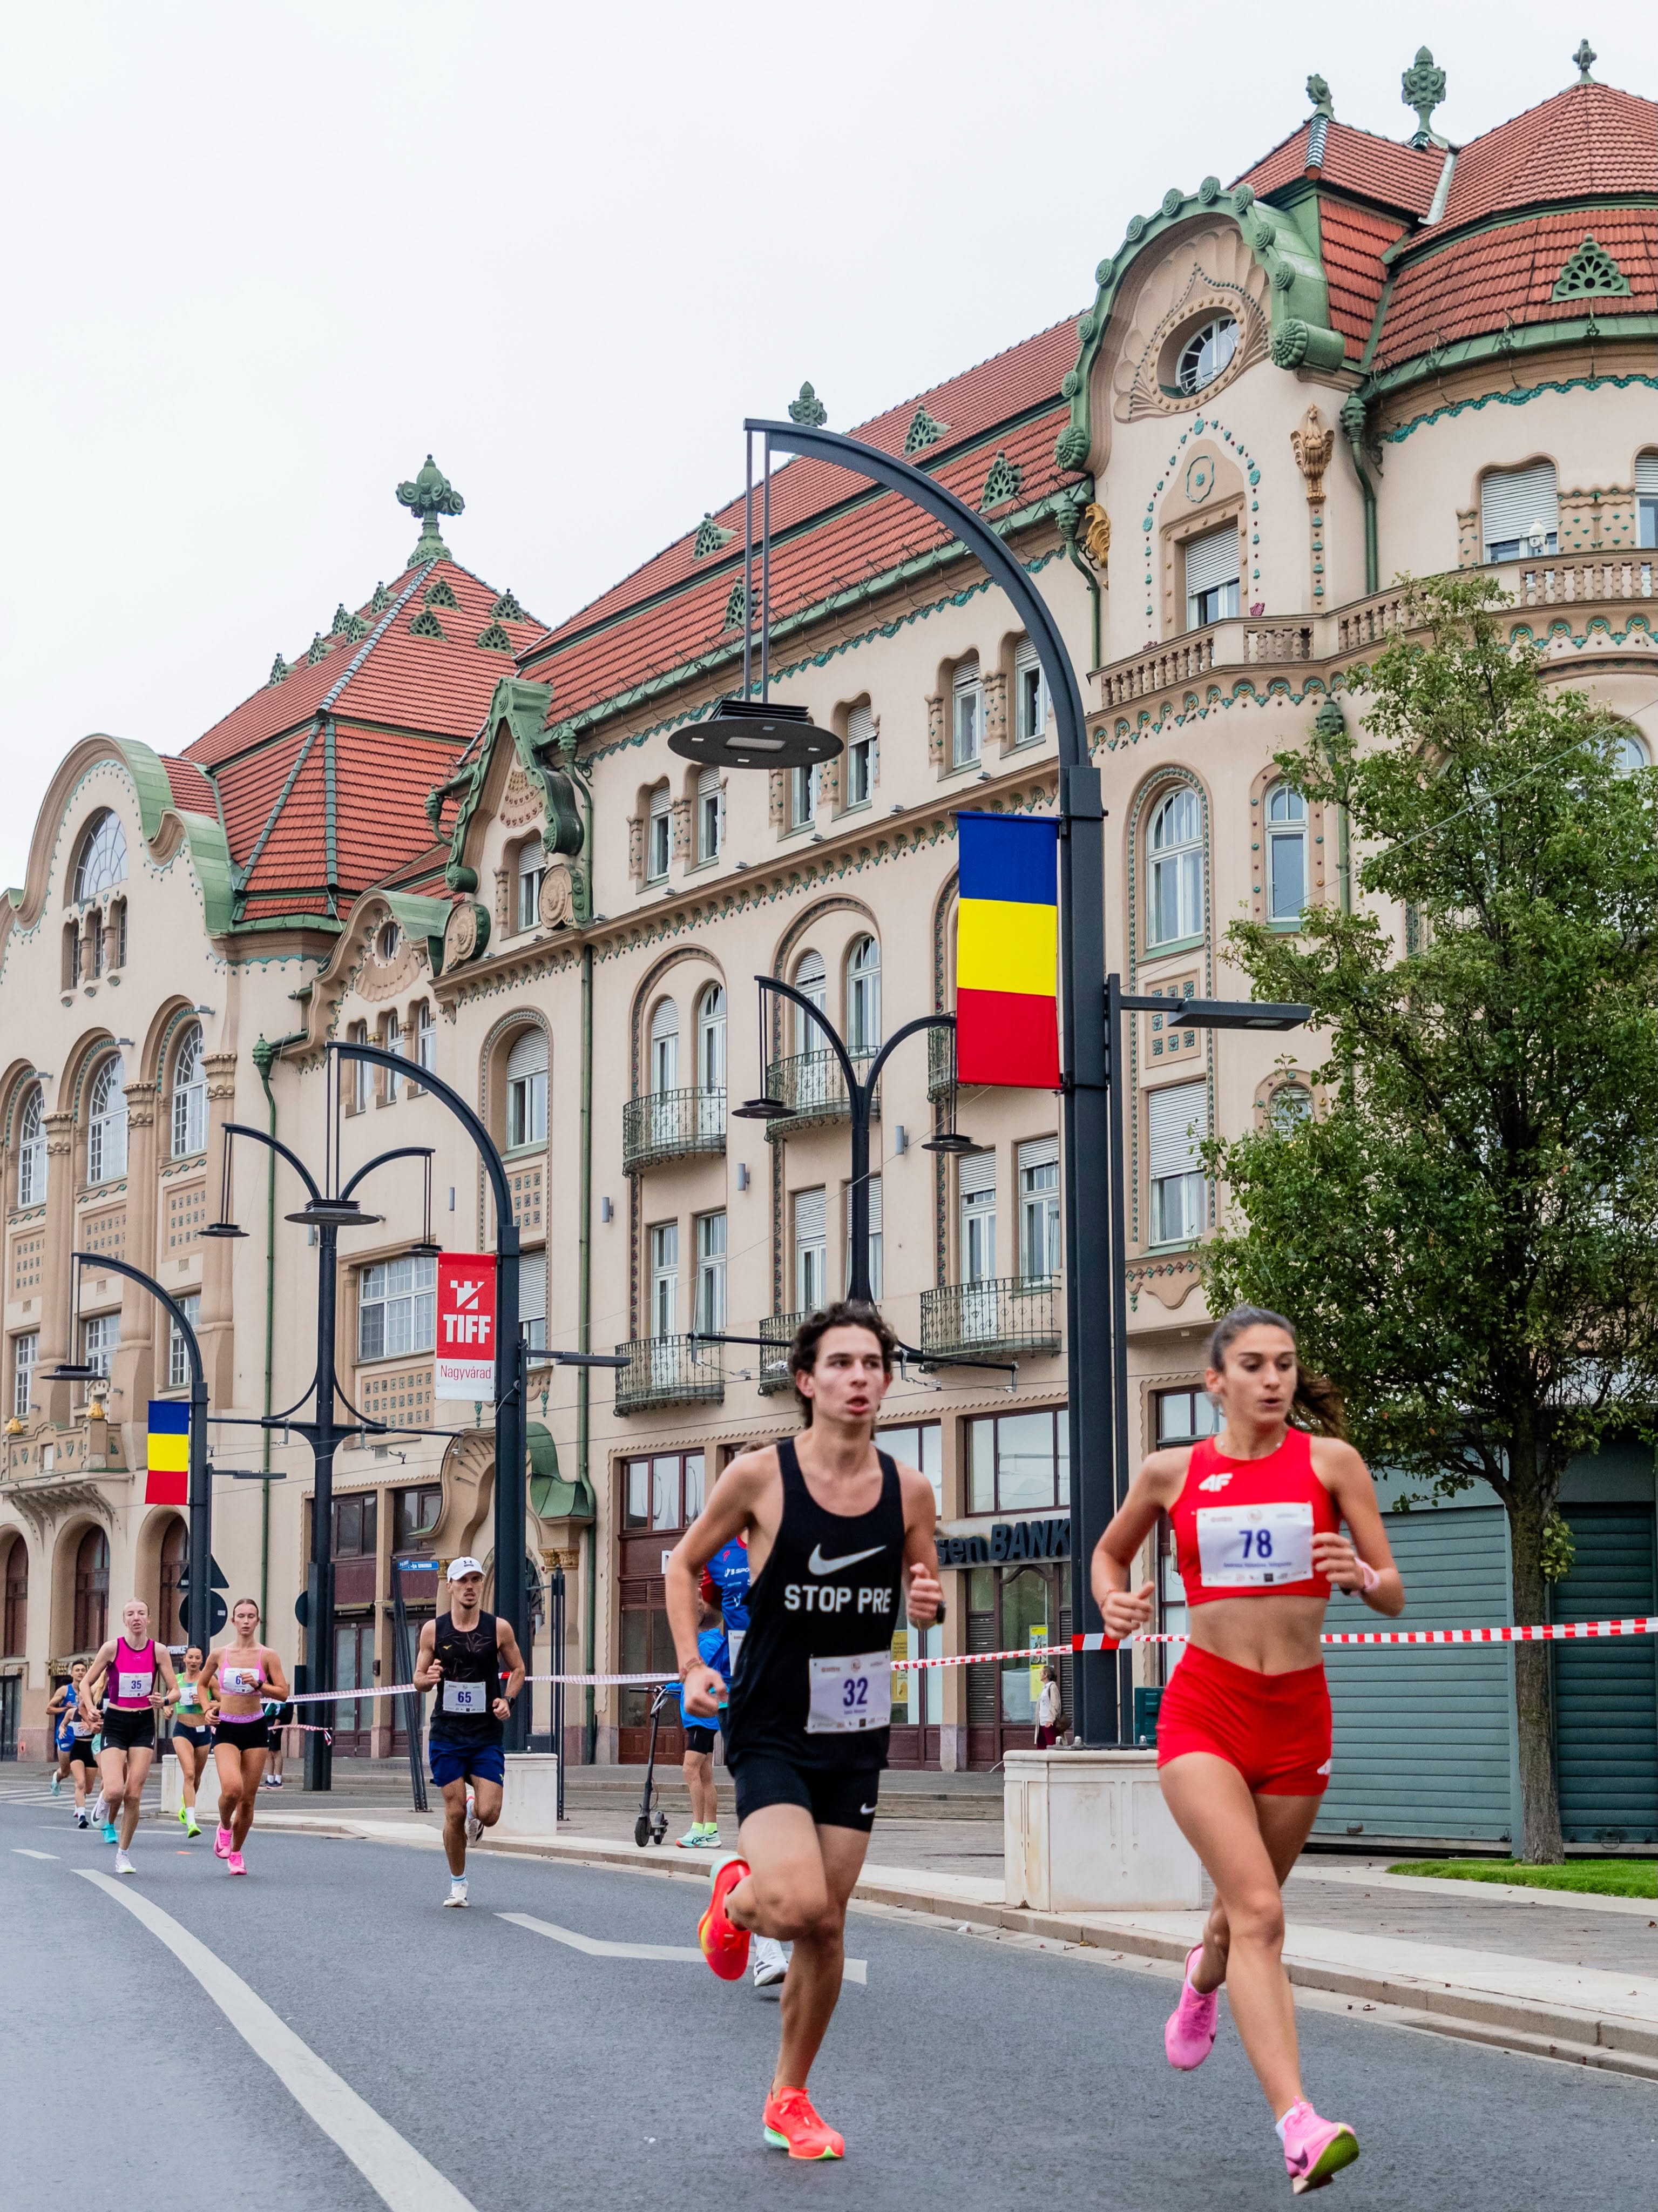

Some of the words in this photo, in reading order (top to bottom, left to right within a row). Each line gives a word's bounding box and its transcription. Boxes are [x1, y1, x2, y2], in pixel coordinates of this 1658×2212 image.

[443, 1314, 491, 1344] TIFF
[441, 1365, 491, 1381] Nagyvárad
[1199, 1473, 1233, 1492] 4F
[938, 1536, 987, 1565] sen
[990, 1518, 1071, 1560] BANK
[1239, 1529, 1273, 1559] 78
[784, 1584, 852, 1613] STOP
[857, 1588, 892, 1614] PRE
[131, 1680, 141, 1689] 35
[235, 1675, 247, 1685] 6
[843, 1676, 868, 1707] 32
[457, 1691, 471, 1703] 65
